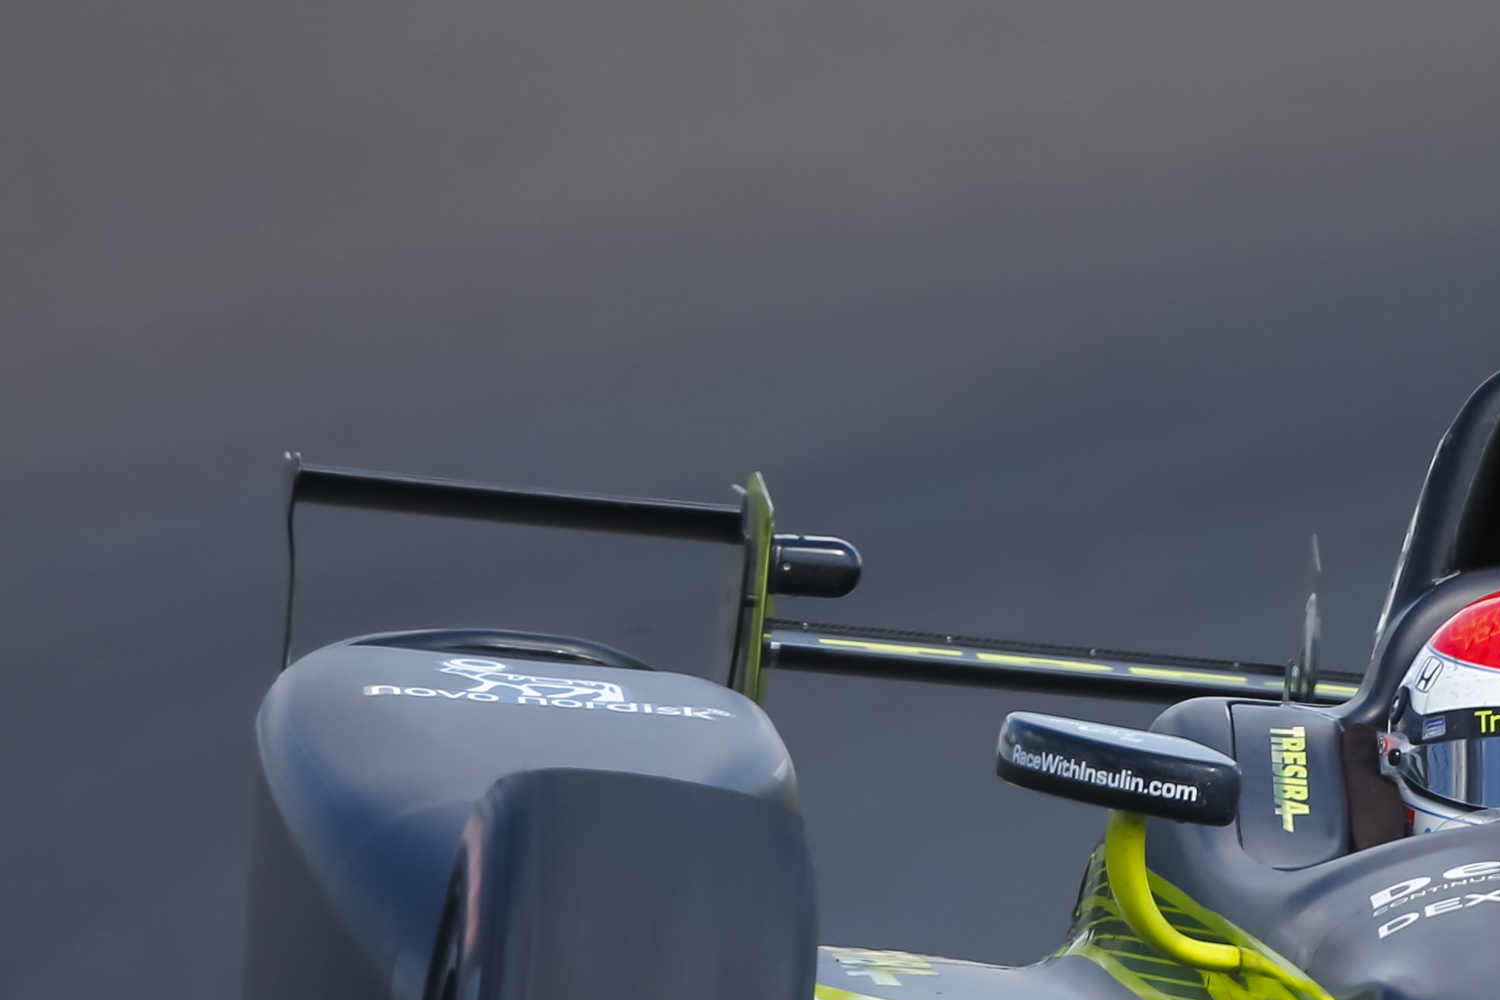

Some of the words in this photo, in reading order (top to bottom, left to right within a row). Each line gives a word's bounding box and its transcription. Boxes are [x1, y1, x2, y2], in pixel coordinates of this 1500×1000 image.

[364, 684, 500, 702] novo
[517, 696, 719, 721] nordisk
[1012, 743, 1198, 802] RaceWithInsulin.com
[1269, 725, 1310, 833] TRESIBA
